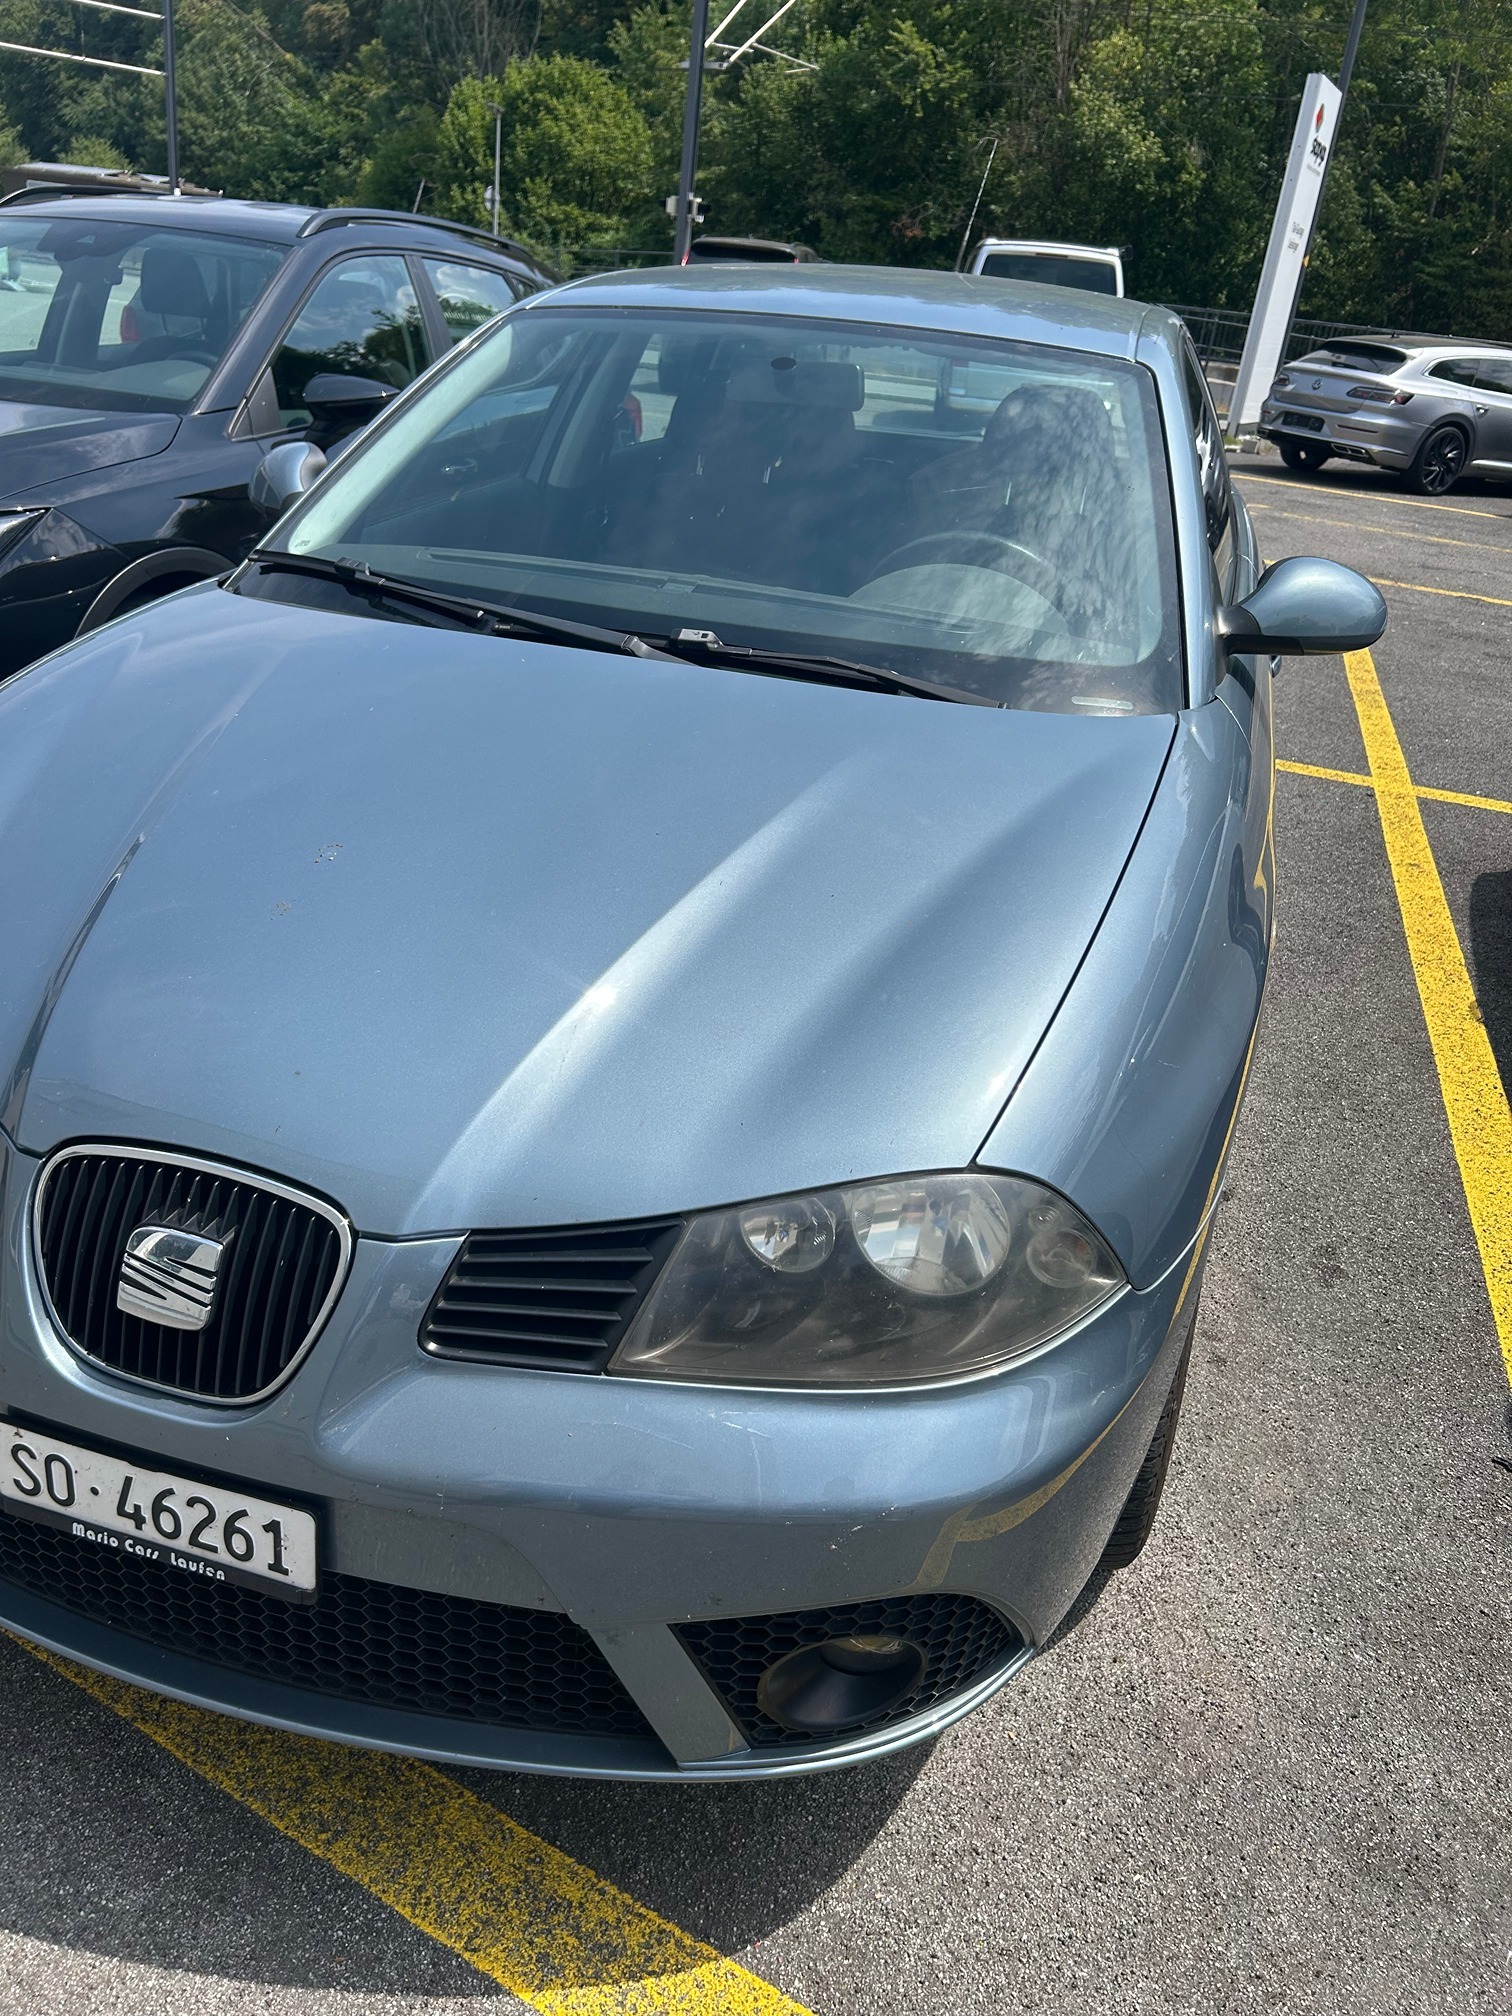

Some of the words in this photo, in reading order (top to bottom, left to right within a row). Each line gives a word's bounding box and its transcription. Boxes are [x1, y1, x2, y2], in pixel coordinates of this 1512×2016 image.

[72, 1521, 119, 1548] Mario
[124, 1538, 160, 1561] Cars
[170, 1552, 226, 1581] Laufen
[116, 1474, 291, 1577] 46261
